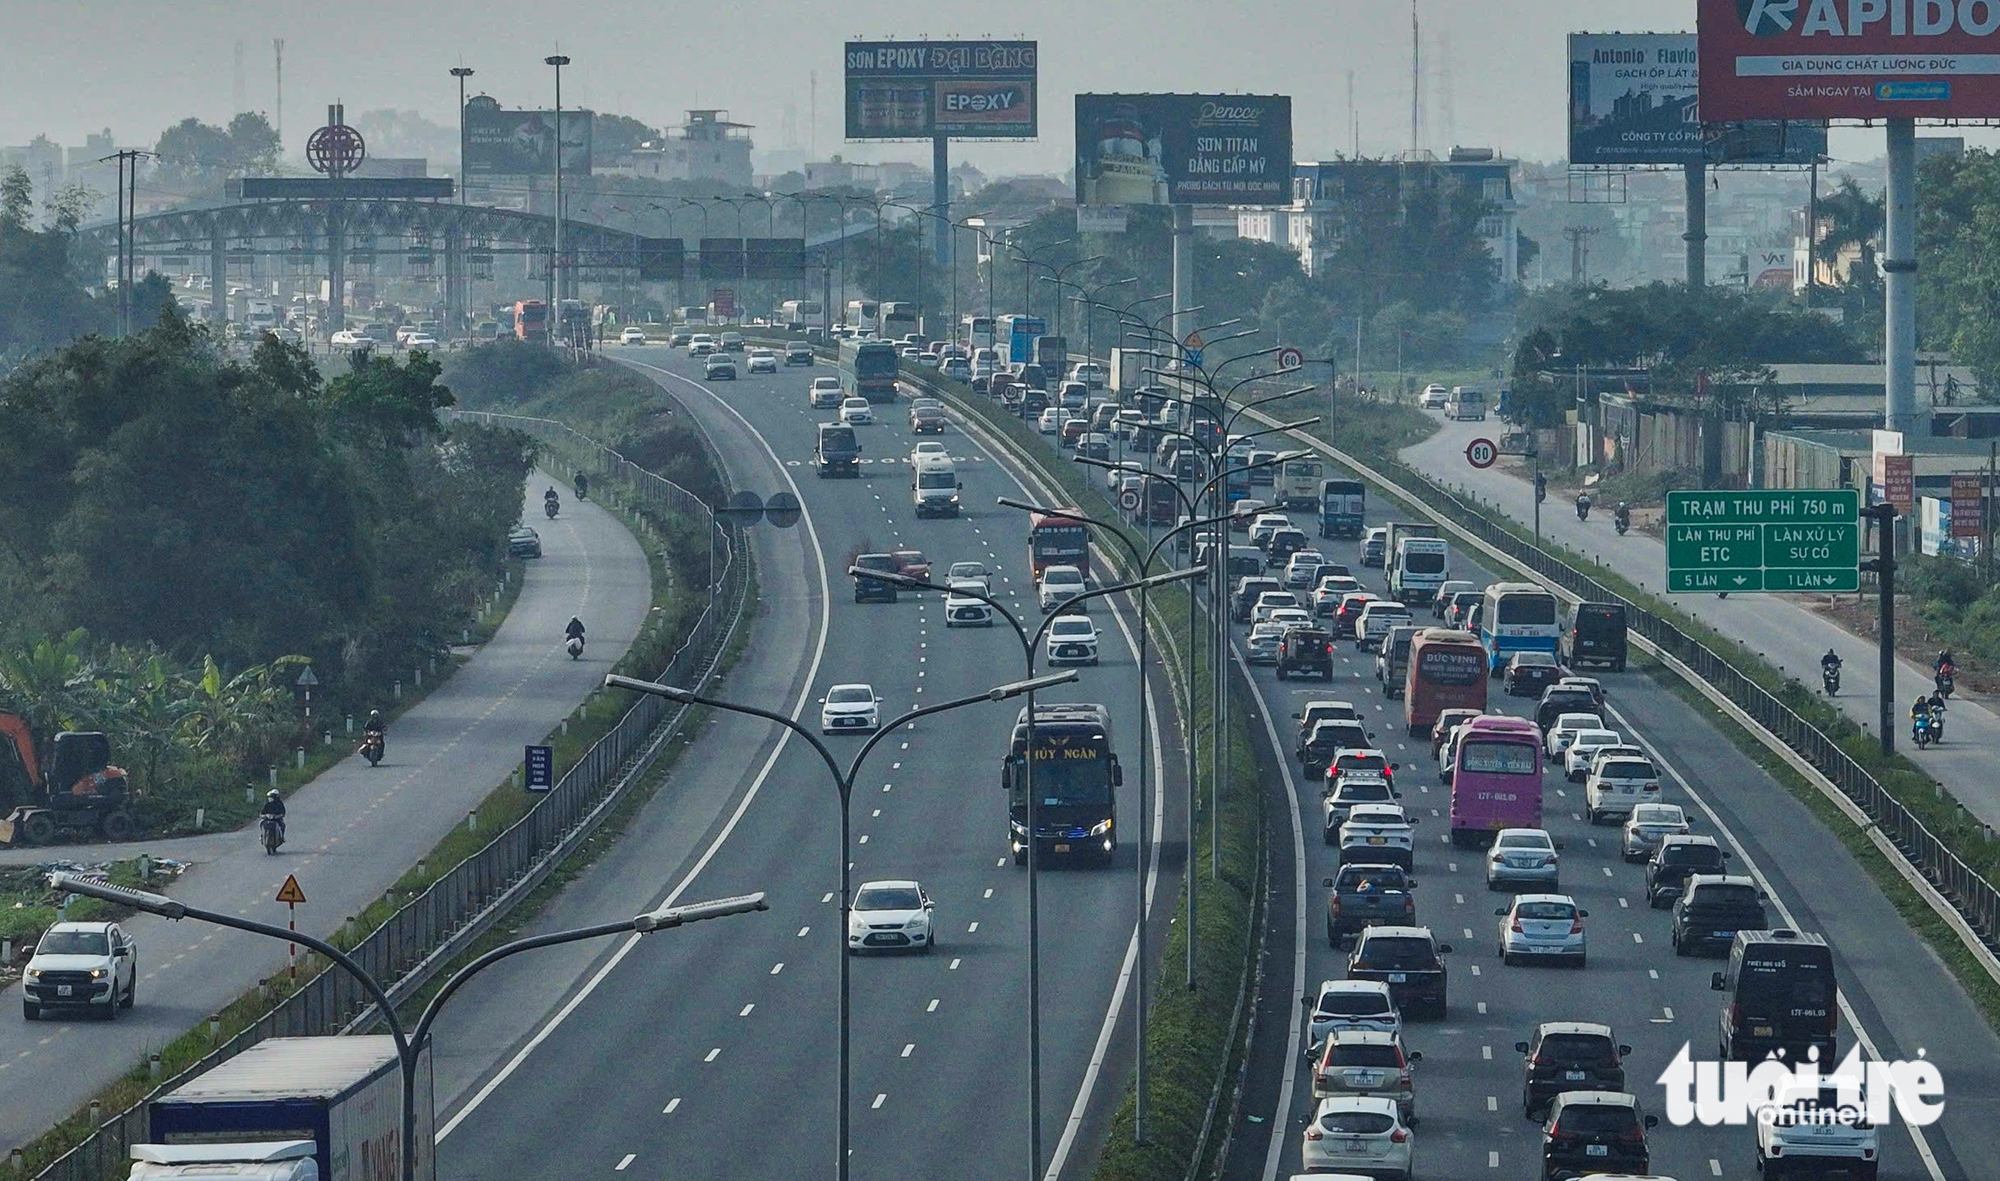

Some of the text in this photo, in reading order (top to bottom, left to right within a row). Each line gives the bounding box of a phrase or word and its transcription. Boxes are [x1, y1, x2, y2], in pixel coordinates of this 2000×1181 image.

[848, 48, 874, 69] SƠN
[877, 48, 927, 68] EPOXY
[931, 47, 970, 73] ĐẠI
[1593, 48, 1645, 65] Antonio
[1782, 58, 1957, 73] GIA DỤNG CHẤT LƯỢNG ĐỨC
[1615, 69, 1647, 80] GẠCH
[1788, 83, 1872, 99] SẮM NGAY TẠI
[946, 91, 1014, 111] EPOXY
[1653, 132, 1670, 141] TY
[1197, 136, 1258, 153] SƠN TITAN
[1285, 355, 1297, 366] 60
[1474, 446, 1489, 460] 80
[1681, 495, 1845, 520] TRẠM THU PHÍ 750 m
[1677, 526, 1755, 541] LÀN THU PHÍ
[1774, 525, 1845, 542] LÀN XỬ LÝ
[1701, 547, 1730, 562] ETC
[1789, 543, 1830, 562] SỰ CỐ
[1684, 572, 1718, 586] 5 LÀN
[1788, 572, 1821, 586] 1 LÀN
